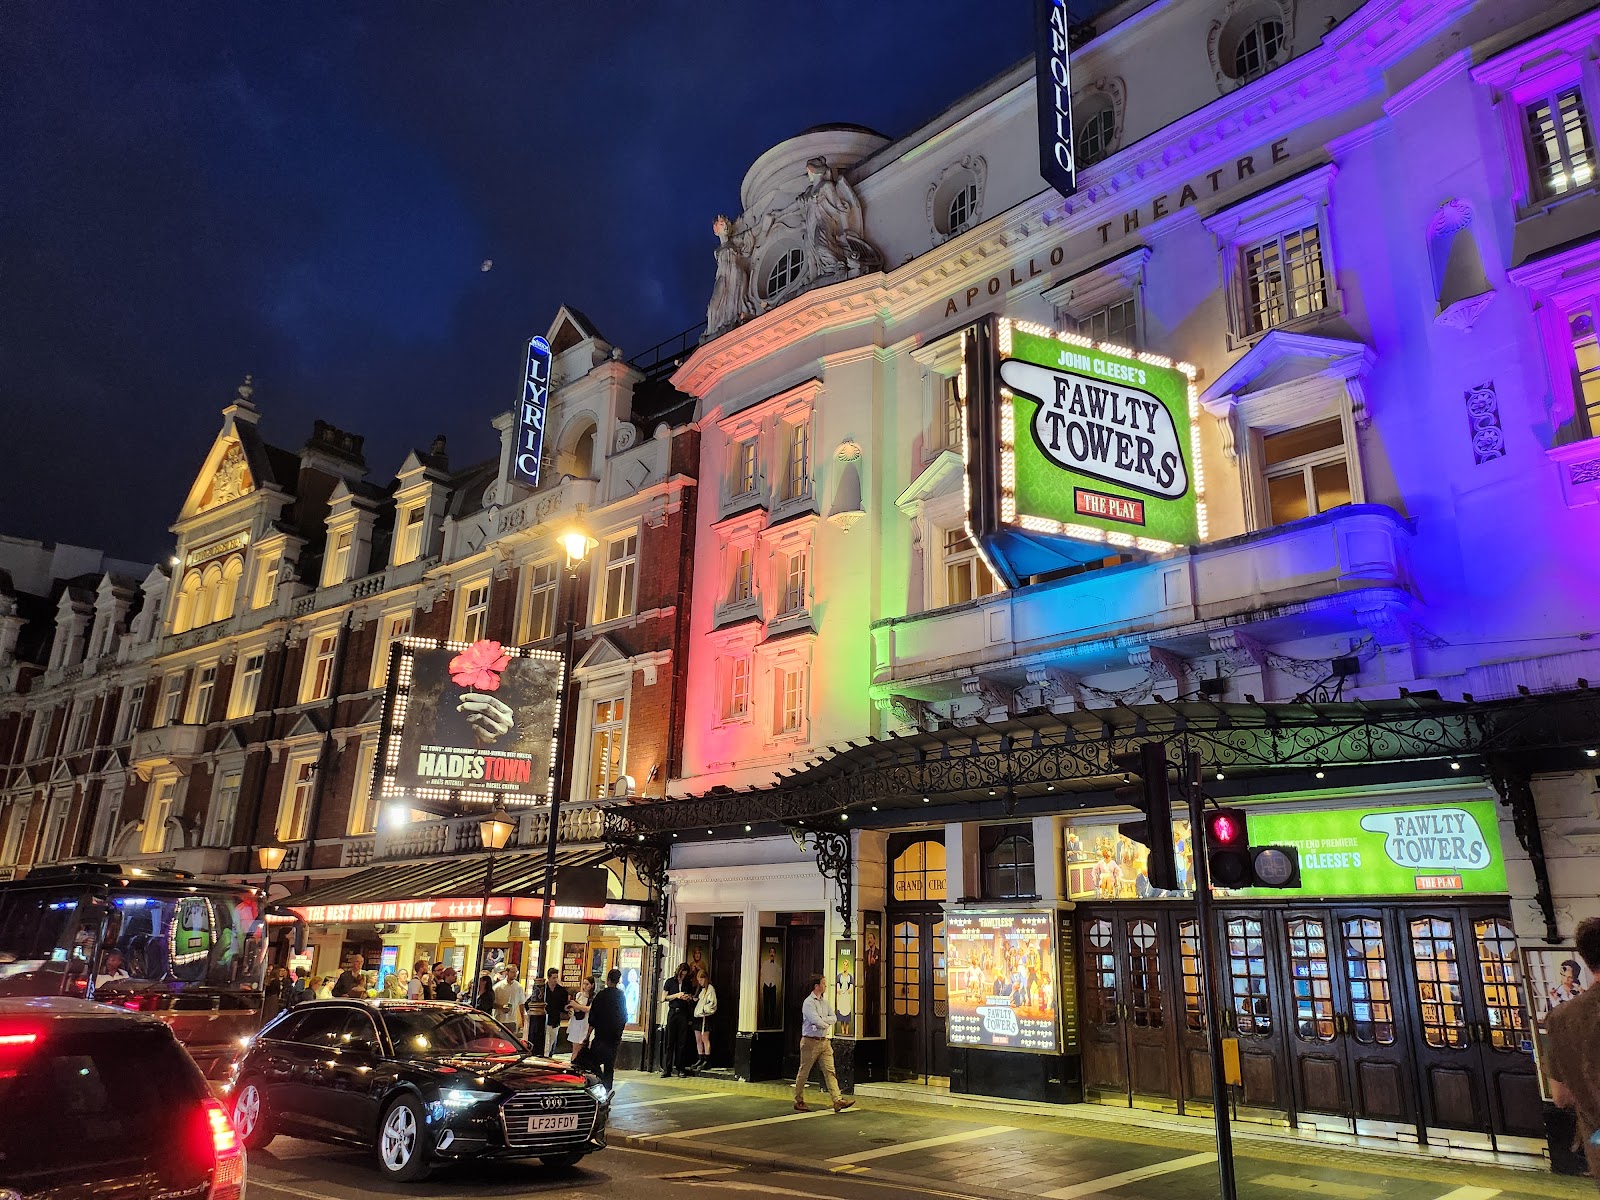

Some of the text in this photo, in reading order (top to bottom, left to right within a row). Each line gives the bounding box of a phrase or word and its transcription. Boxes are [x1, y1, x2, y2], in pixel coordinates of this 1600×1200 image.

[1051, 6, 1072, 173] APOLLO
[945, 138, 1290, 317] APOLLO THEATRE
[1058, 350, 1146, 385] JOHN CLEESE'S
[518, 358, 546, 476] LYRIC
[1053, 375, 1158, 435] FAWLTY
[1045, 411, 1177, 488] TOWERS
[1084, 494, 1136, 520] THE PLAY
[417, 752, 532, 783] HADESTOWN
[1394, 813, 1465, 837] FAWLTY
[1306, 839, 1320, 849] END
[1322, 837, 1358, 848] PREMIERE
[1392, 836, 1483, 864] TOWERS
[1306, 852, 1361, 869] CLEESE'S
[896, 879, 924, 892] GRAND
[1421, 876, 1456, 888] THE PLAY
[327, 905, 351, 920] BEST
[351, 904, 383, 920] SHOW
[384, 903, 397, 919] IN
[987, 1018, 1017, 1033] TOWERS
[988, 1008, 1012, 1019] FAWLTY
[532, 1116, 575, 1130] LF23 FDY
